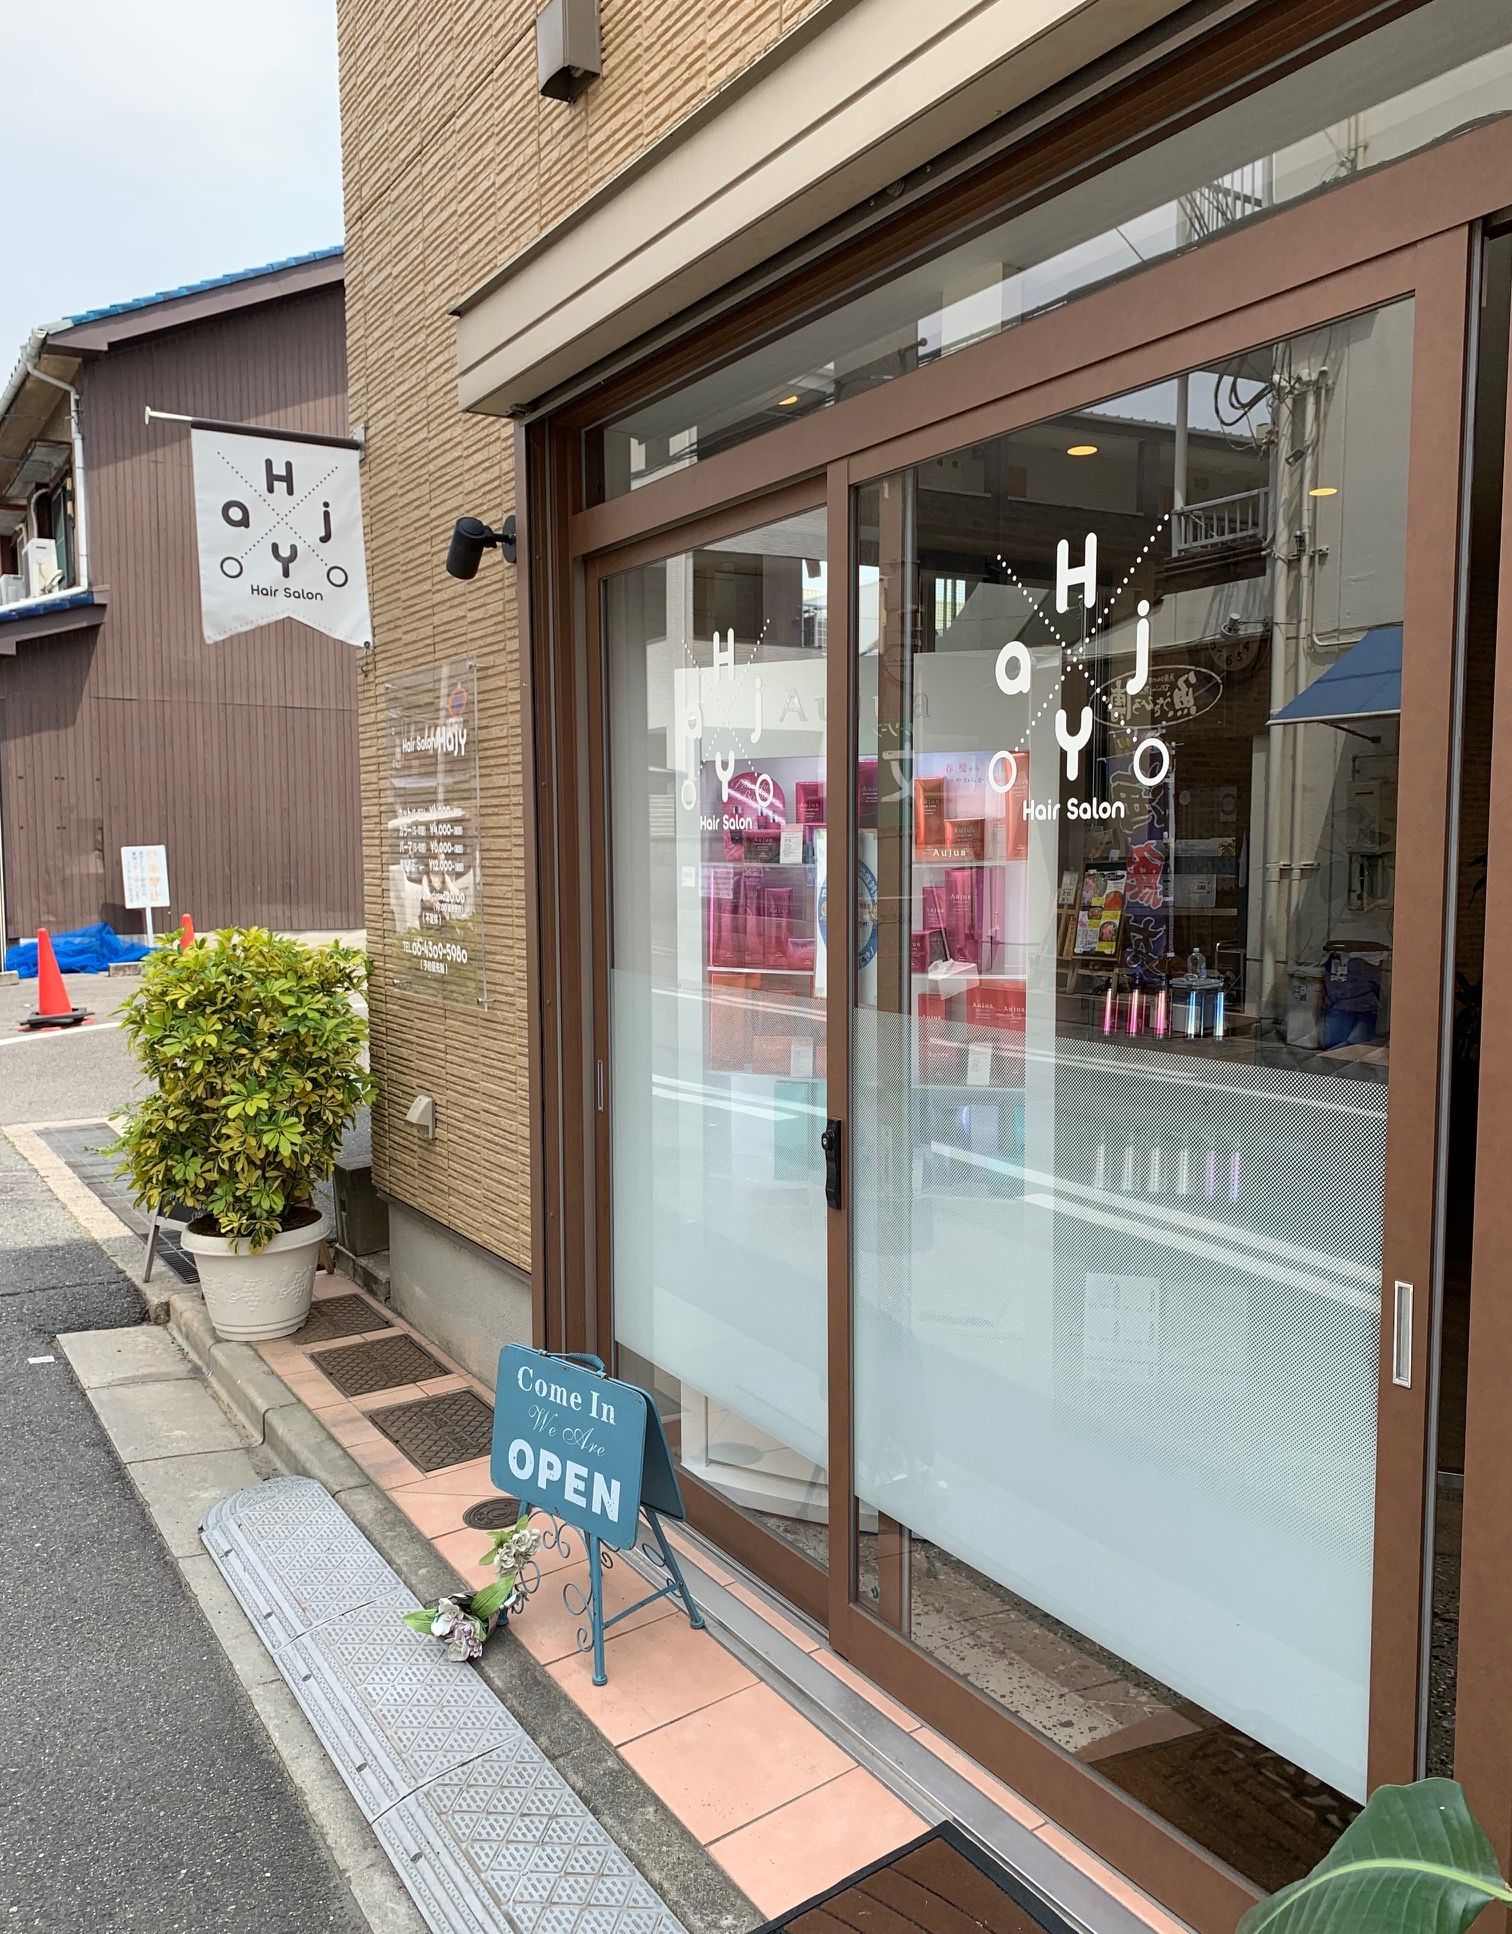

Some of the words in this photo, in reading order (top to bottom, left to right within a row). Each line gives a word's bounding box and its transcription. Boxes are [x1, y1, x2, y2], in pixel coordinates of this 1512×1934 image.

[265, 458, 294, 496] H
[1055, 532, 1097, 614] H
[250, 584, 279, 599] Hair
[283, 586, 324, 601] Salon
[700, 814, 719, 831] Hair
[722, 814, 753, 830] Salon
[1022, 799, 1061, 822] Hair
[1066, 797, 1126, 820] Salon
[932, 848, 966, 859] Aujua
[517, 1366, 582, 1411] Come
[589, 1390, 616, 1426] In
[528, 1404, 558, 1437] We
[562, 1427, 606, 1457] Are
[508, 1438, 621, 1523] OPEN
